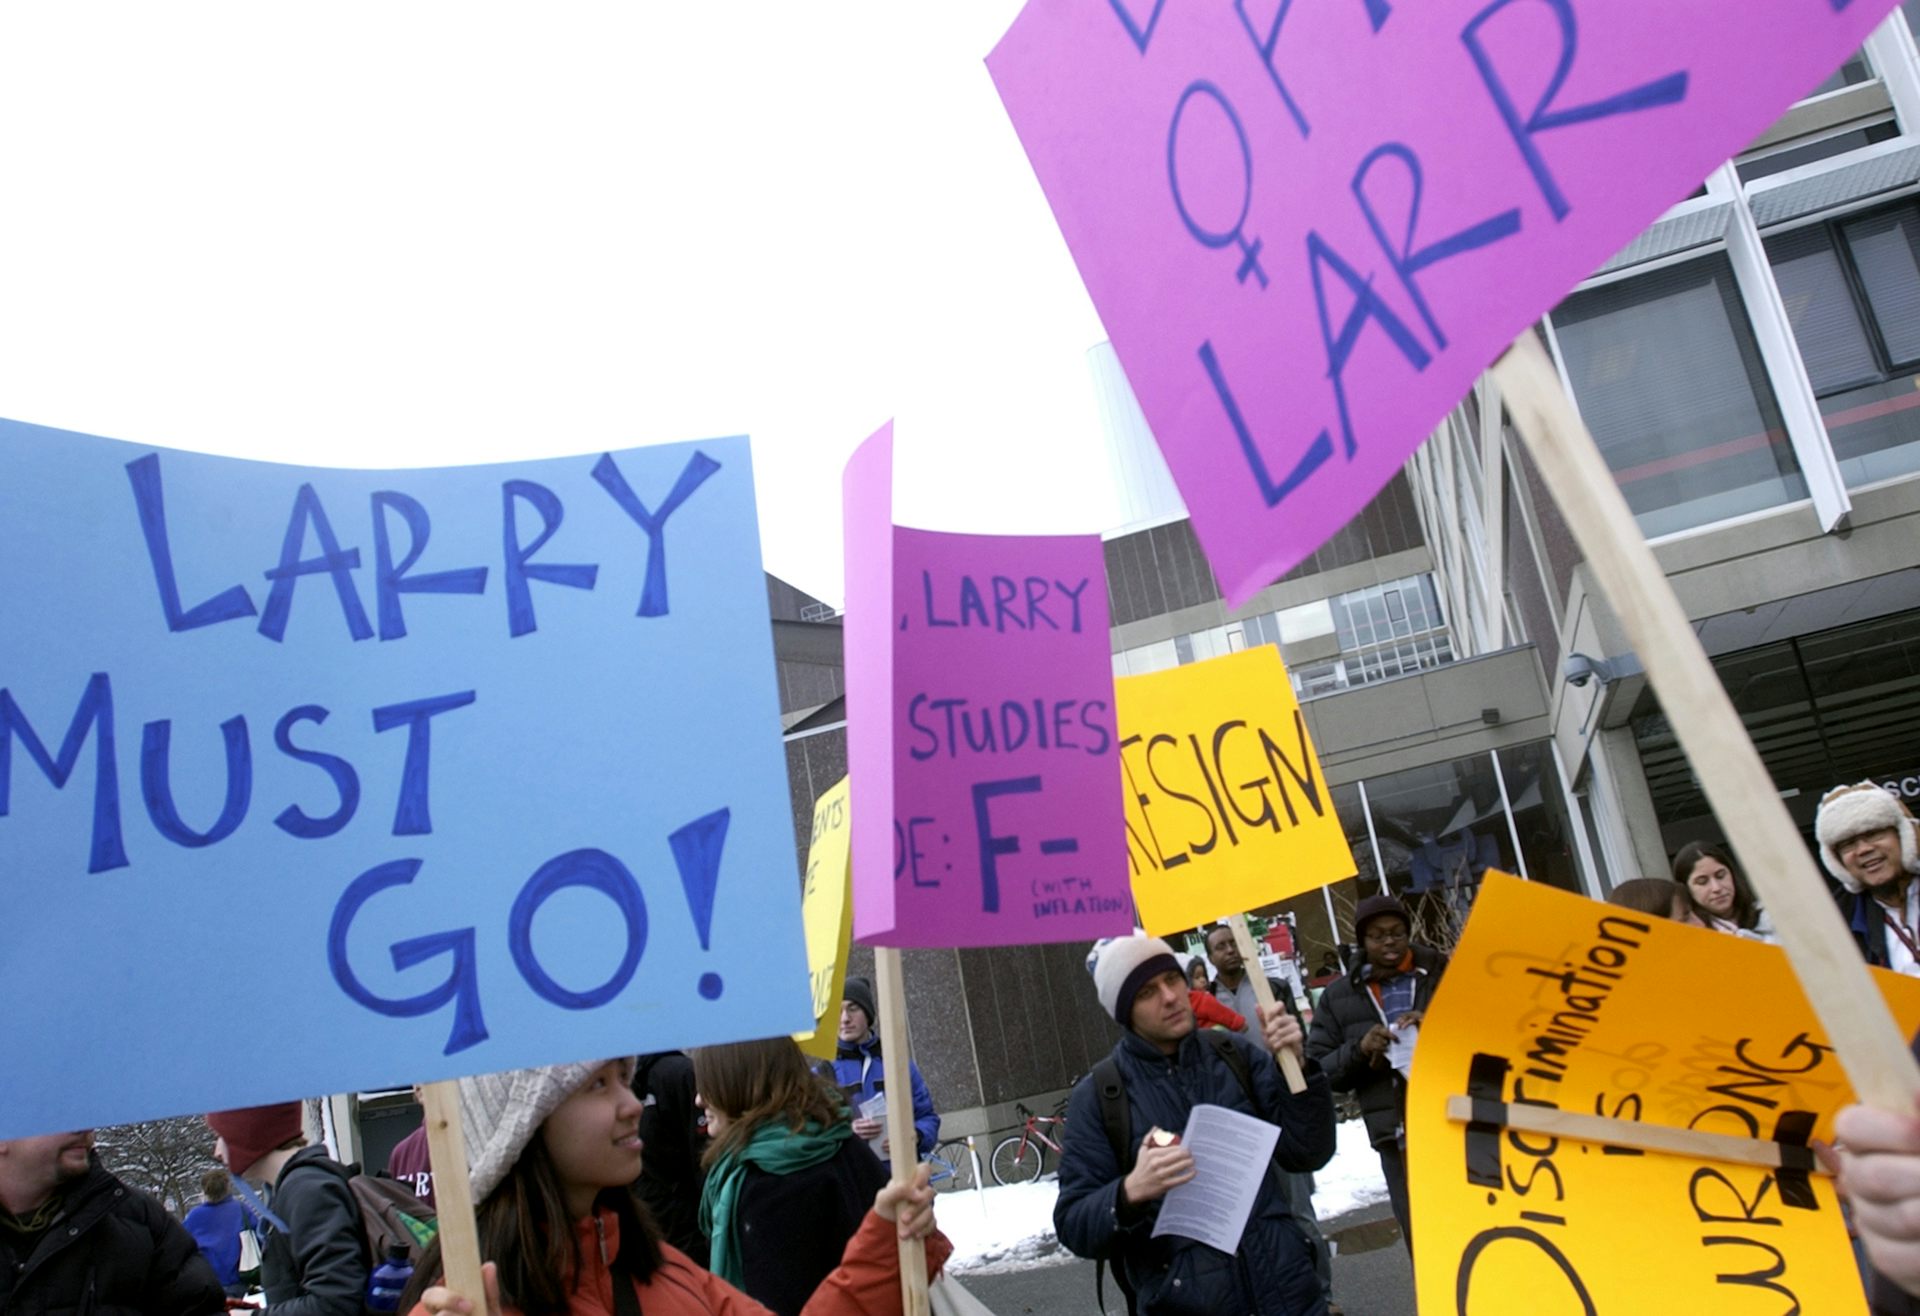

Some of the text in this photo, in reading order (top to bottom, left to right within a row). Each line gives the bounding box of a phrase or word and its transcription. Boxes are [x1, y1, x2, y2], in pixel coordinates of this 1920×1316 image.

[1197, 0, 1854, 508] LARR
[126, 450, 722, 642] LARRY
[922, 569, 1089, 633] LARRY
[0, 672, 476, 875] MUST
[909, 693, 1110, 761] STUDIES
[327, 806, 731, 1057] GO!
